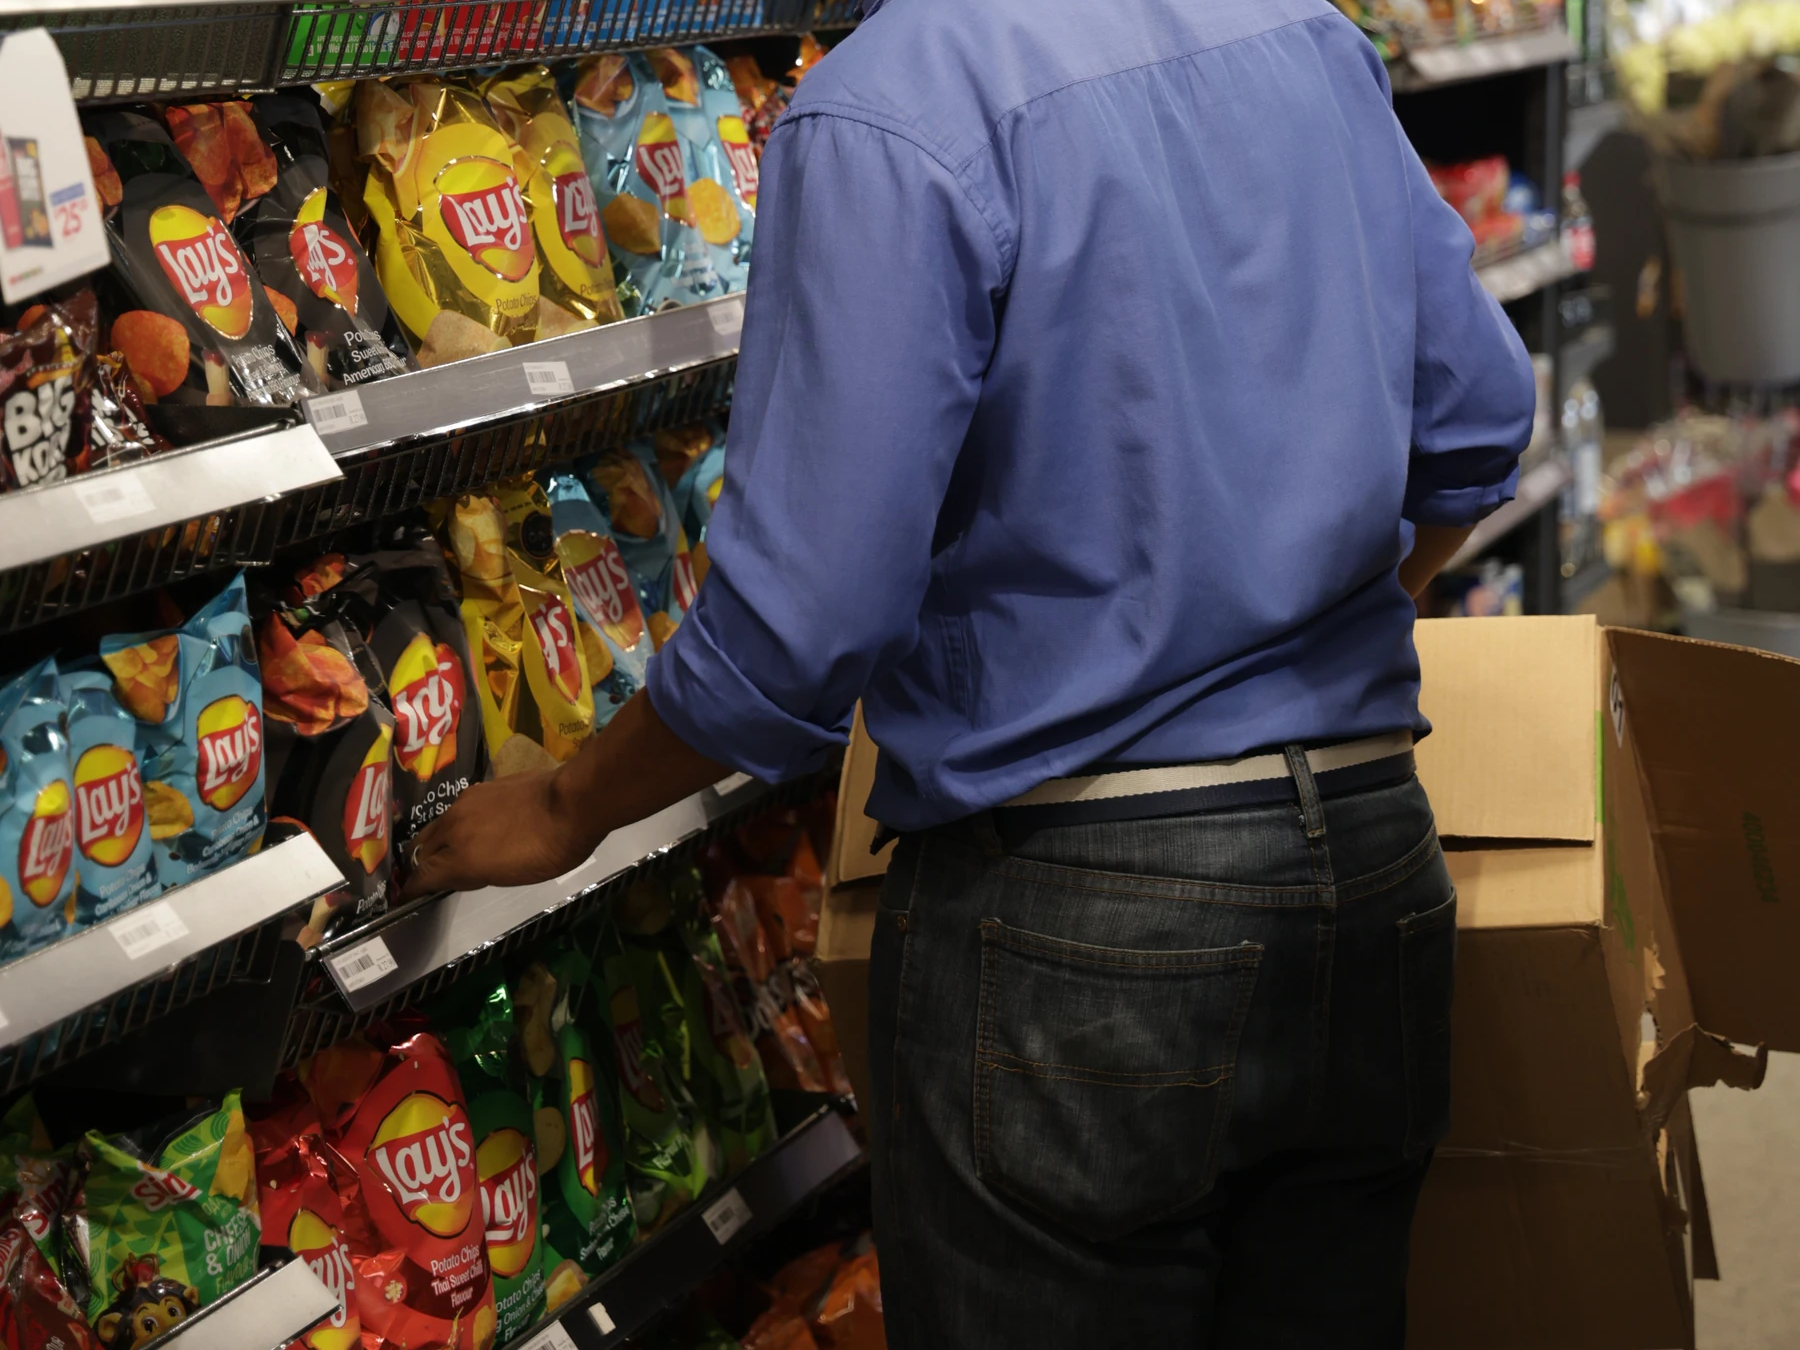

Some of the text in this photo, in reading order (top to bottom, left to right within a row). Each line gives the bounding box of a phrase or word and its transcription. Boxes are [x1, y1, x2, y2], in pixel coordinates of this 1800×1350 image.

[451, 175, 528, 251] Lay's
[158, 224, 240, 307] Lay's
[495, 292, 537, 315] Potato Chips
[5, 376, 76, 452] BIG
[200, 711, 261, 792] Lay's
[437, 776, 470, 798] Chps
[77, 761, 142, 846] Lay's
[375, 1115, 471, 1205] Lay's
[480, 1147, 537, 1243] Lay's
[205, 1252, 223, 1276] &
[308, 1234, 355, 1329] ay's
[430, 1243, 480, 1277] Potato Chips
[430, 1276, 450, 1297] Thai
[449, 1268, 470, 1290] Sweet
[450, 1285, 474, 1309] Flavour
[495, 1268, 541, 1313] otato Chips
